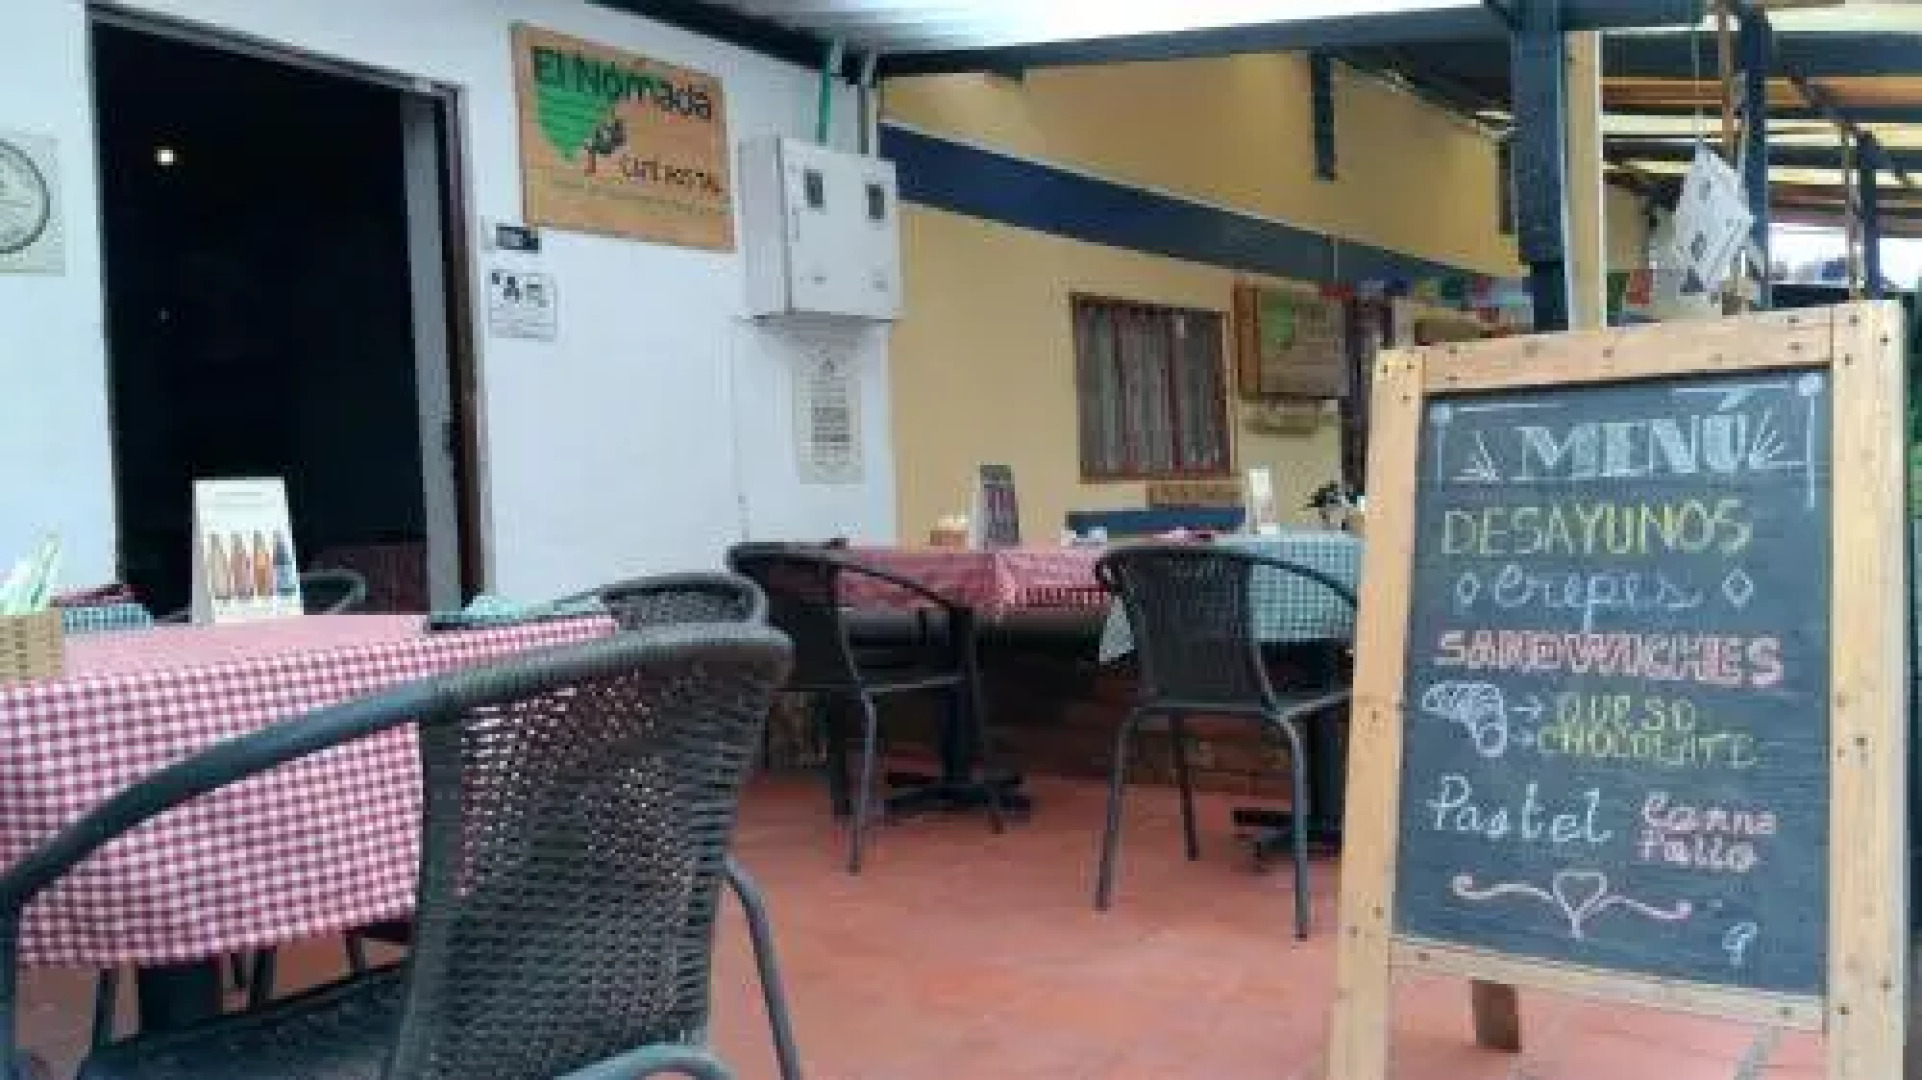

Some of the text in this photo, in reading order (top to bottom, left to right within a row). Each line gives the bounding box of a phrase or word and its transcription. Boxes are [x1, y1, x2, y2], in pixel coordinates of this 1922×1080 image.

[532, 46, 567, 84] El
[1441, 498, 1753, 556] DESAYUNOS
[1493, 563, 1703, 632] Crepes
[1434, 628, 1785, 688] SANDWICHES
[1555, 691, 1698, 733] QUESO
[1427, 773, 1614, 844] Pastel
